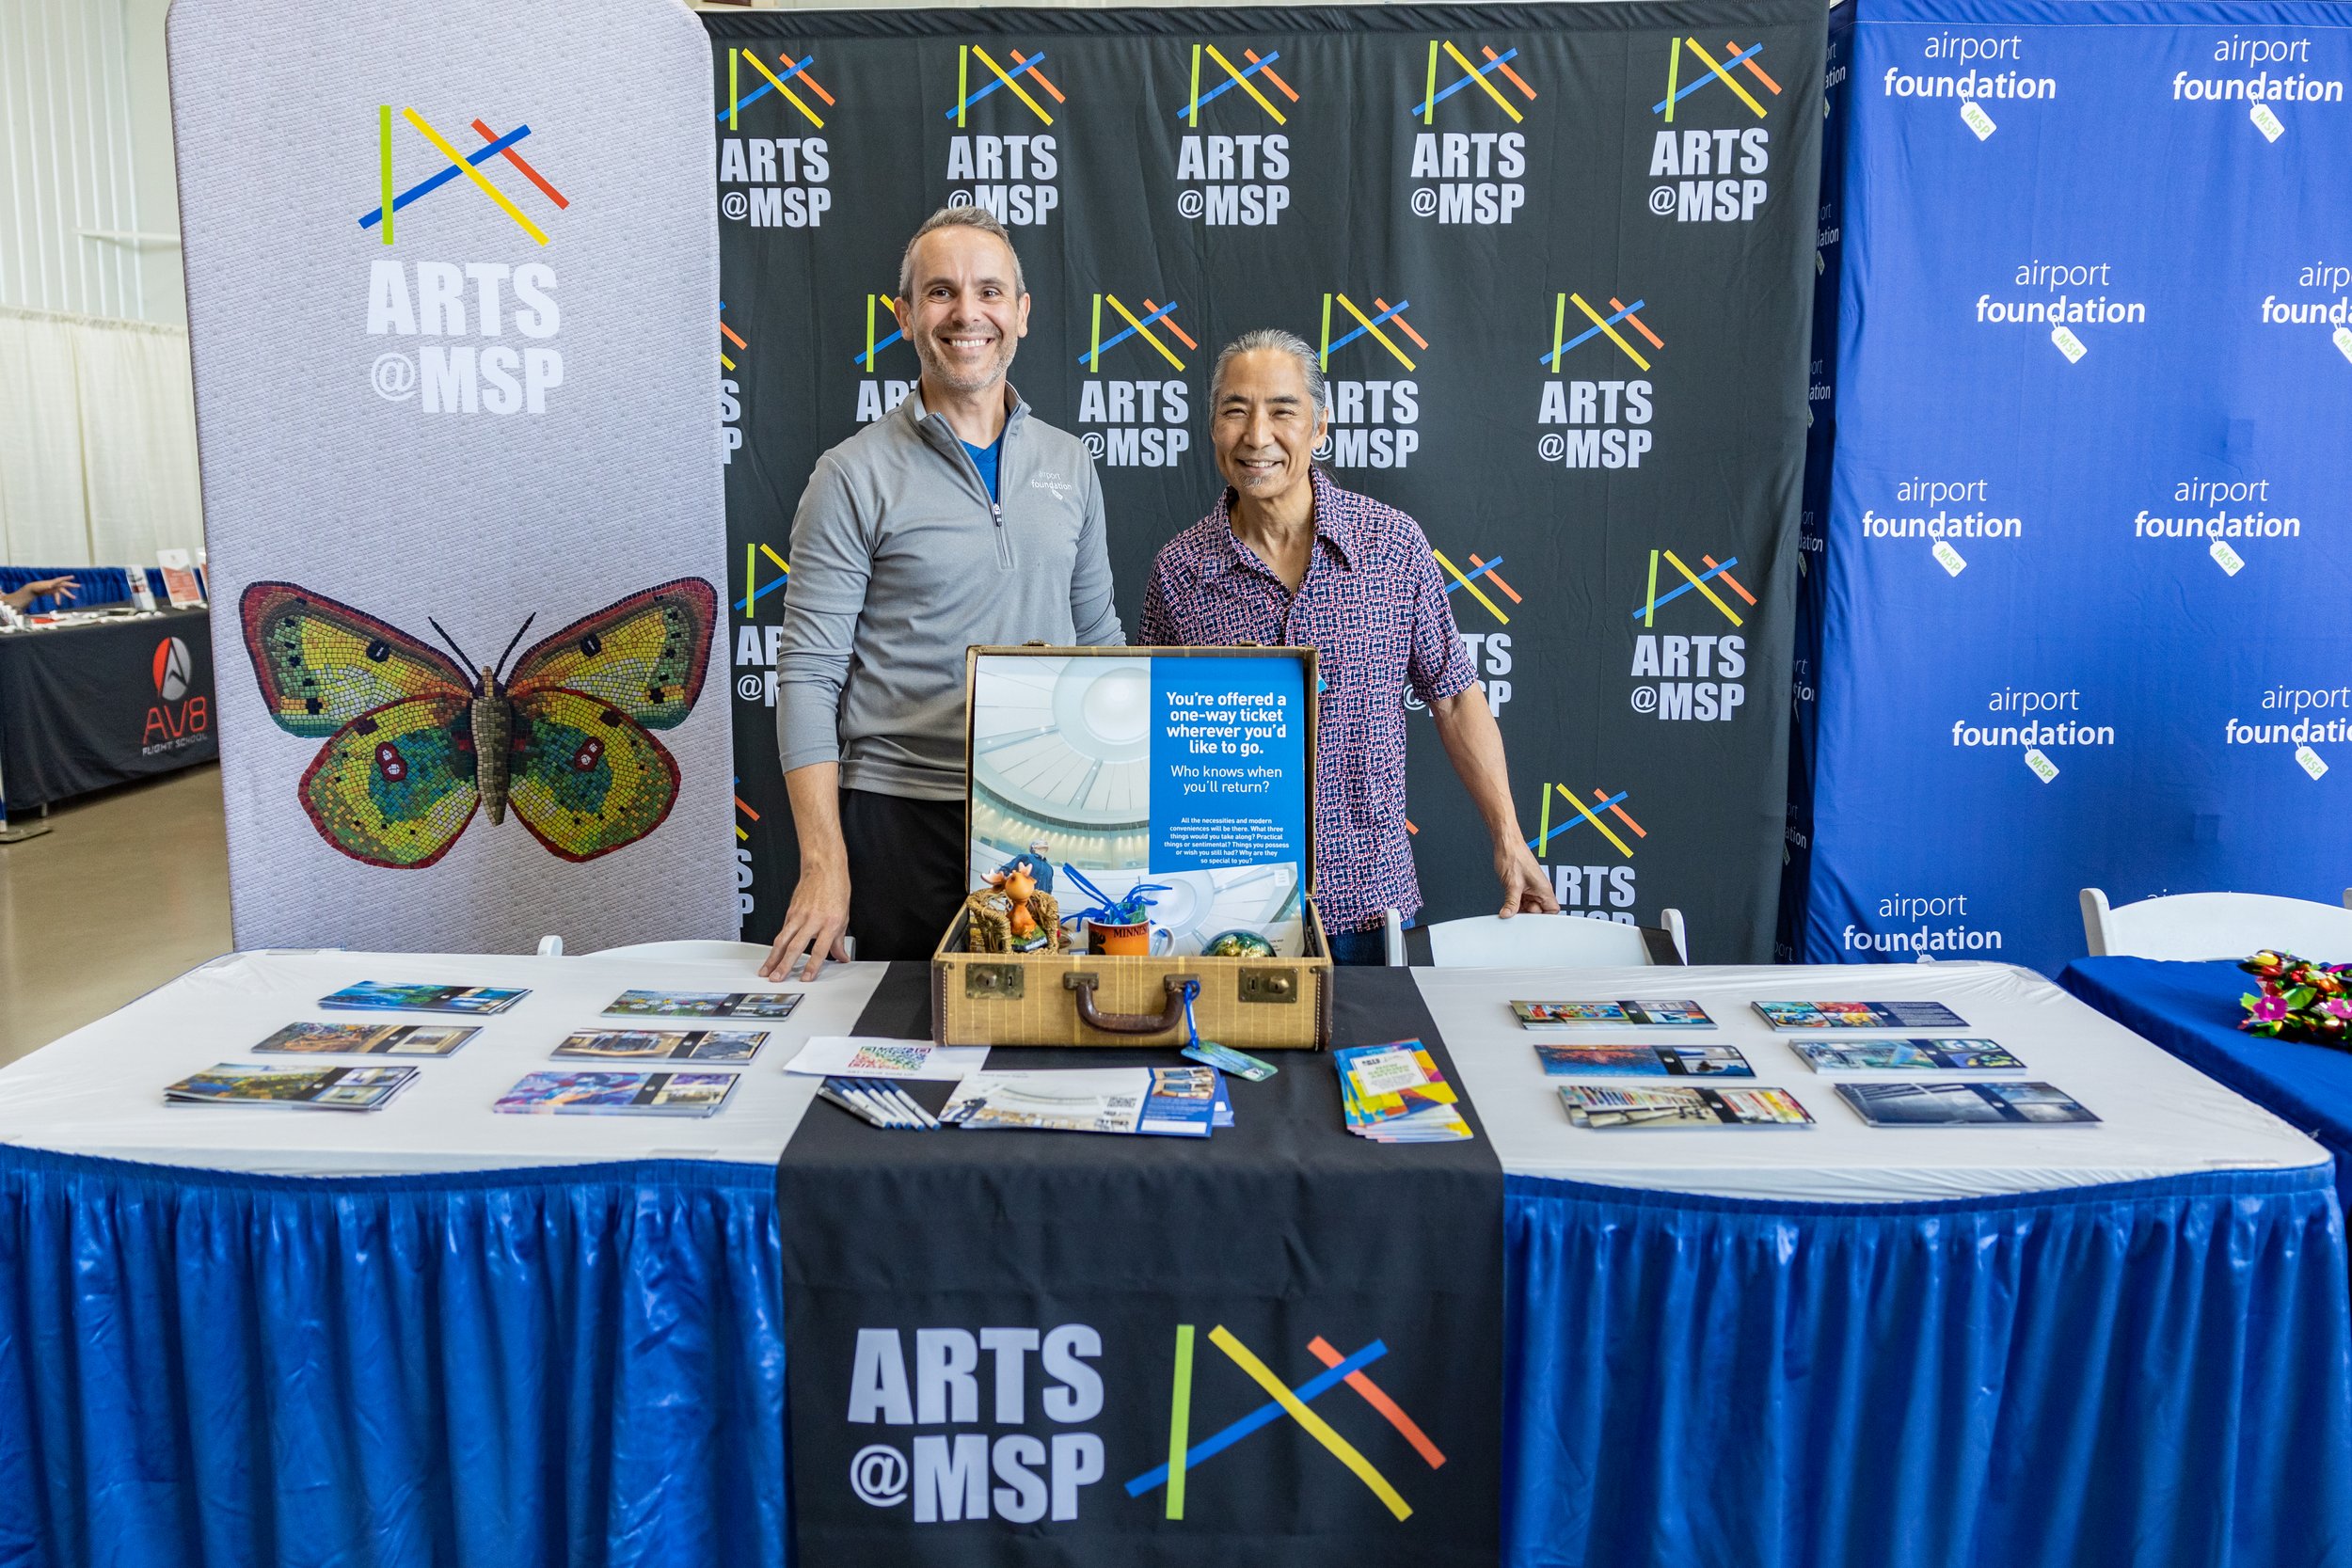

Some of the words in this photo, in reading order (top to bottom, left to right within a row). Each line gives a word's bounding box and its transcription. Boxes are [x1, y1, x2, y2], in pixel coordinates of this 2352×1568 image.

[1924, 31, 2022, 66] airport
[2214, 34, 2312, 69] airport
[1883, 67, 2057, 99] foundation
[2172, 71, 2344, 101] foundation
[1967, 108, 1992, 135] MSP
[2255, 110, 2279, 136] MSP
[721, 136, 830, 182] ARTS
[946, 135, 1057, 180] ARTS
[1177, 134, 1290, 180] ARTS
[1411, 132, 1525, 179] ARTS
[1649, 127, 1769, 176] ARTS
[722, 187, 831, 228] @MSP
[1177, 184, 1290, 226] @MSP
[1411, 182, 1525, 224] @MSP
[1649, 180, 1768, 222] @MSP
[2015, 259, 2111, 293] airport
[2299, 261, 2352, 293] airp
[366, 260, 562, 340] ARTS
[1976, 294, 2146, 324] foundation
[2058, 333, 2082, 358] MSP
[371, 345, 564, 415] @MSP
[856, 380, 918, 422] AR
[1078, 380, 1189, 423] ARTS
[1537, 379, 1653, 424] ARTS
[1081, 427, 1189, 467] @MSP
[1537, 429, 1652, 468] @MSP
[1031, 478, 1073, 491] foundation
[1897, 476, 1988, 507] airport
[2174, 476, 2270, 508] airport
[1862, 511, 2022, 538] foundation
[2135, 510, 2300, 538] foundation
[1938, 546, 1963, 573] MSP
[2216, 546, 2240, 572] MSP
[1460, 632, 1513, 675] TS
[1630, 635, 1745, 678] ARTS
[1167, 691, 1214, 706] You're
[1217, 691, 1274, 706] offered
[1277, 695, 1287, 706] a
[1630, 683, 1745, 721] @MSP
[1988, 687, 2080, 718] airport
[2262, 684, 2351, 715] airport
[142, 696, 208, 747] AV8
[1166, 723, 1242, 737] wherever
[1245, 723, 1287, 741] you'd
[1169, 710, 1237, 725] one-way
[1240, 708, 1283, 721] ticket
[142, 740, 173, 756] FLIGHT
[175, 732, 209, 749] SCHOOL
[1189, 739, 1217, 753] like
[1221, 742, 1236, 753] to
[1240, 744, 1264, 757] go.
[1951, 720, 2115, 746] foundation
[1170, 765, 1200, 778] Who
[1203, 765, 1245, 778] knows
[1248, 765, 1282, 778] when
[2030, 754, 2056, 781] MSP
[2300, 752, 2324, 776] MSP
[1184, 781, 1218, 795] you'll
[1221, 781, 1270, 793] return?
[1879, 893, 1968, 923] airport
[1842, 924, 2002, 951] foundation
[848, 1323, 1104, 1424] ARTS
[850, 1433, 1104, 1523] @MSP
